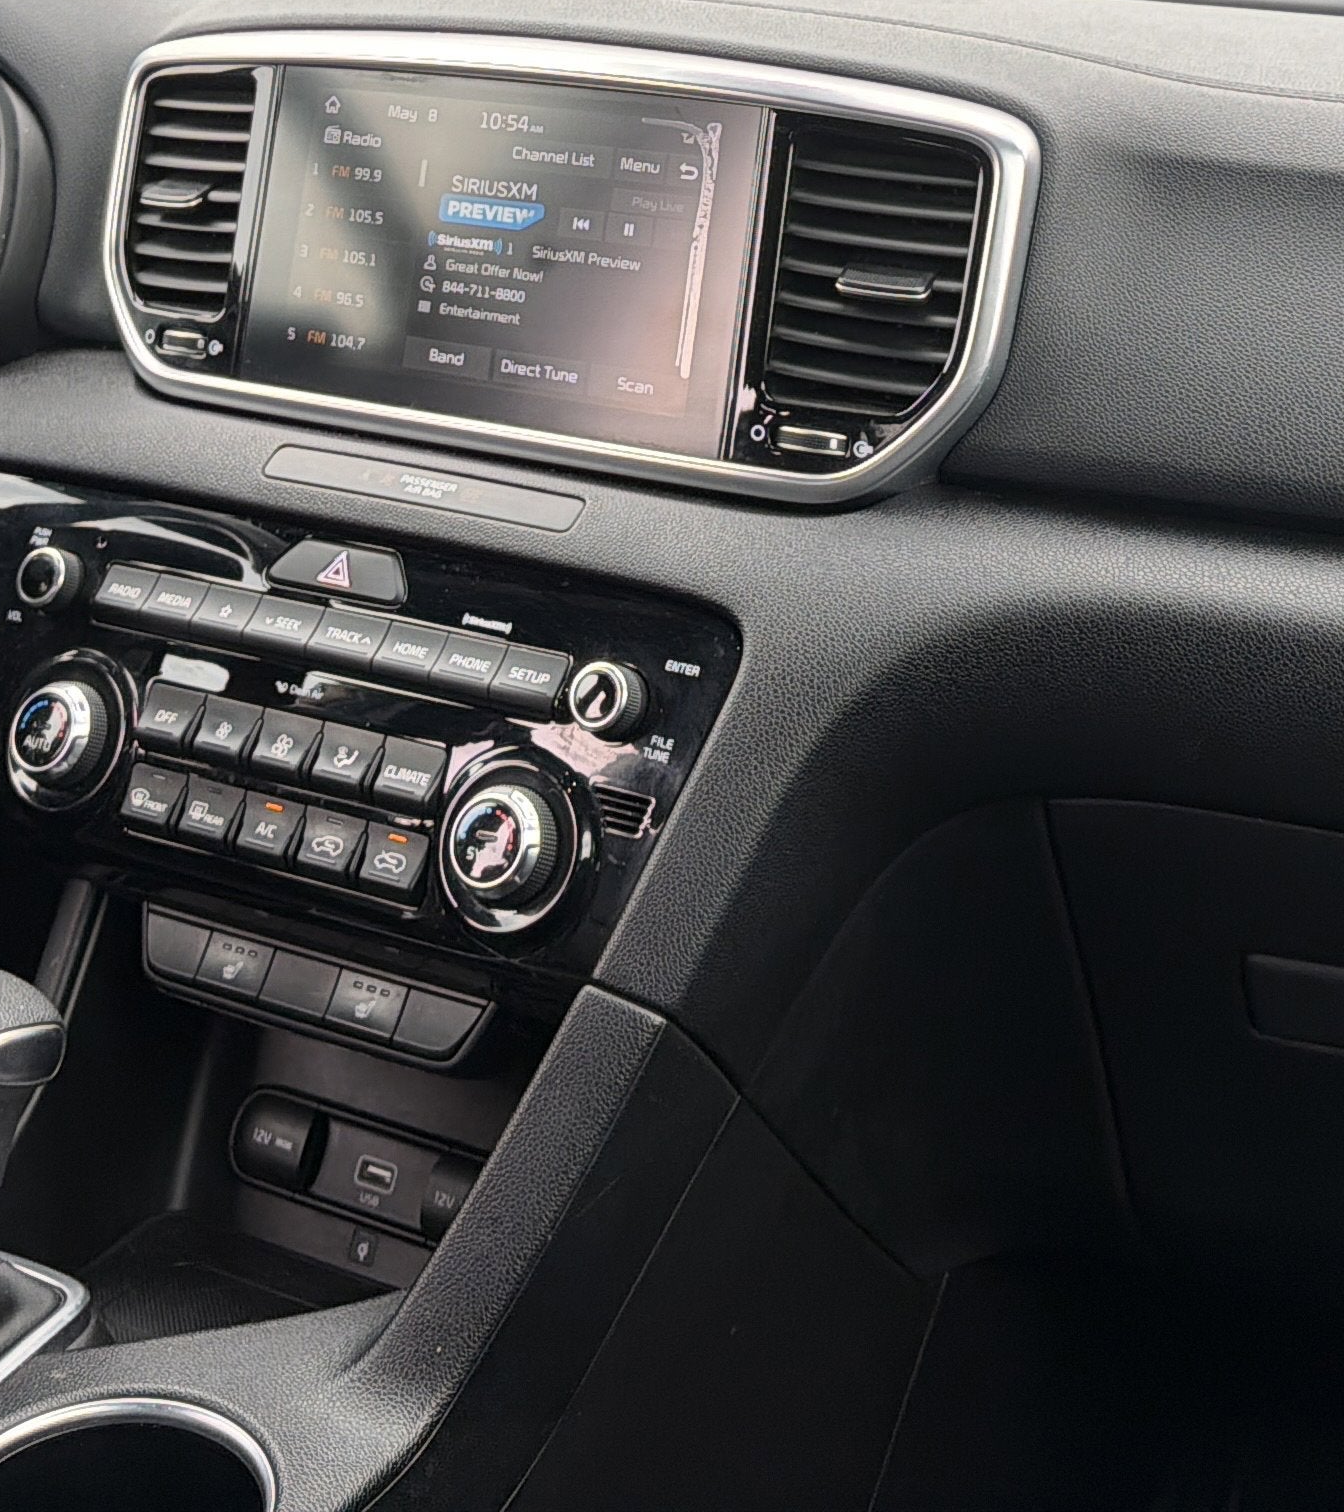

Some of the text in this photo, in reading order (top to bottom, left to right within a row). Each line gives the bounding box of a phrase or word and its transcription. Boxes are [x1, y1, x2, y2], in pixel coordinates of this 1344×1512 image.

[387, 104, 438, 123] May 8
[480, 111, 530, 132] 10:54
[343, 131, 382, 148] Radio
[512, 146, 595, 168] Channel List
[620, 157, 660, 175] Menu
[312, 162, 383, 183] 1 FM 99.9
[451, 175, 538, 201] SIRIUSXM
[305, 203, 384, 225] 2 FM 105.5
[447, 200, 535, 224] PREVIEW
[632, 196, 684, 213] Play Live
[300, 244, 376, 267] 3 FM 105.1
[532, 245, 585, 265] SiriusXM
[587, 252, 641, 272] Preview
[445, 258, 544, 284] Great Offer Now!
[293, 286, 364, 308] 4 FM 96.5
[442, 280, 526, 304] 844-711-8800
[439, 303, 521, 326] Entertainment
[287, 326, 366, 351] 5 FM 104.7
[429, 348, 465, 367] Band
[500, 358, 578, 384] Direct Tune
[617, 377, 654, 396] Scan
[399, 473, 458, 493] PASSENGER
[421, 487, 444, 499] BAG
[107, 582, 142, 599] RADIO
[157, 591, 192, 608] MEDIA
[274, 615, 302, 631] SEEK
[327, 626, 362, 643] TRACK
[393, 641, 430, 659] HOME
[449, 653, 492, 673] PHONE
[664, 659, 701, 678] ENTER
[508, 666, 551, 684] SETUP
[154, 709, 179, 724] OFF
[22, 734, 53, 752] AUTO
[650, 734, 675, 751] FILE
[643, 746, 670, 764] TUNE
[383, 764, 432, 787] CLIMATE
[254, 821, 278, 839] A/C
[253, 1127, 272, 1146] 12V
[434, 1190, 456, 1209] 12V
